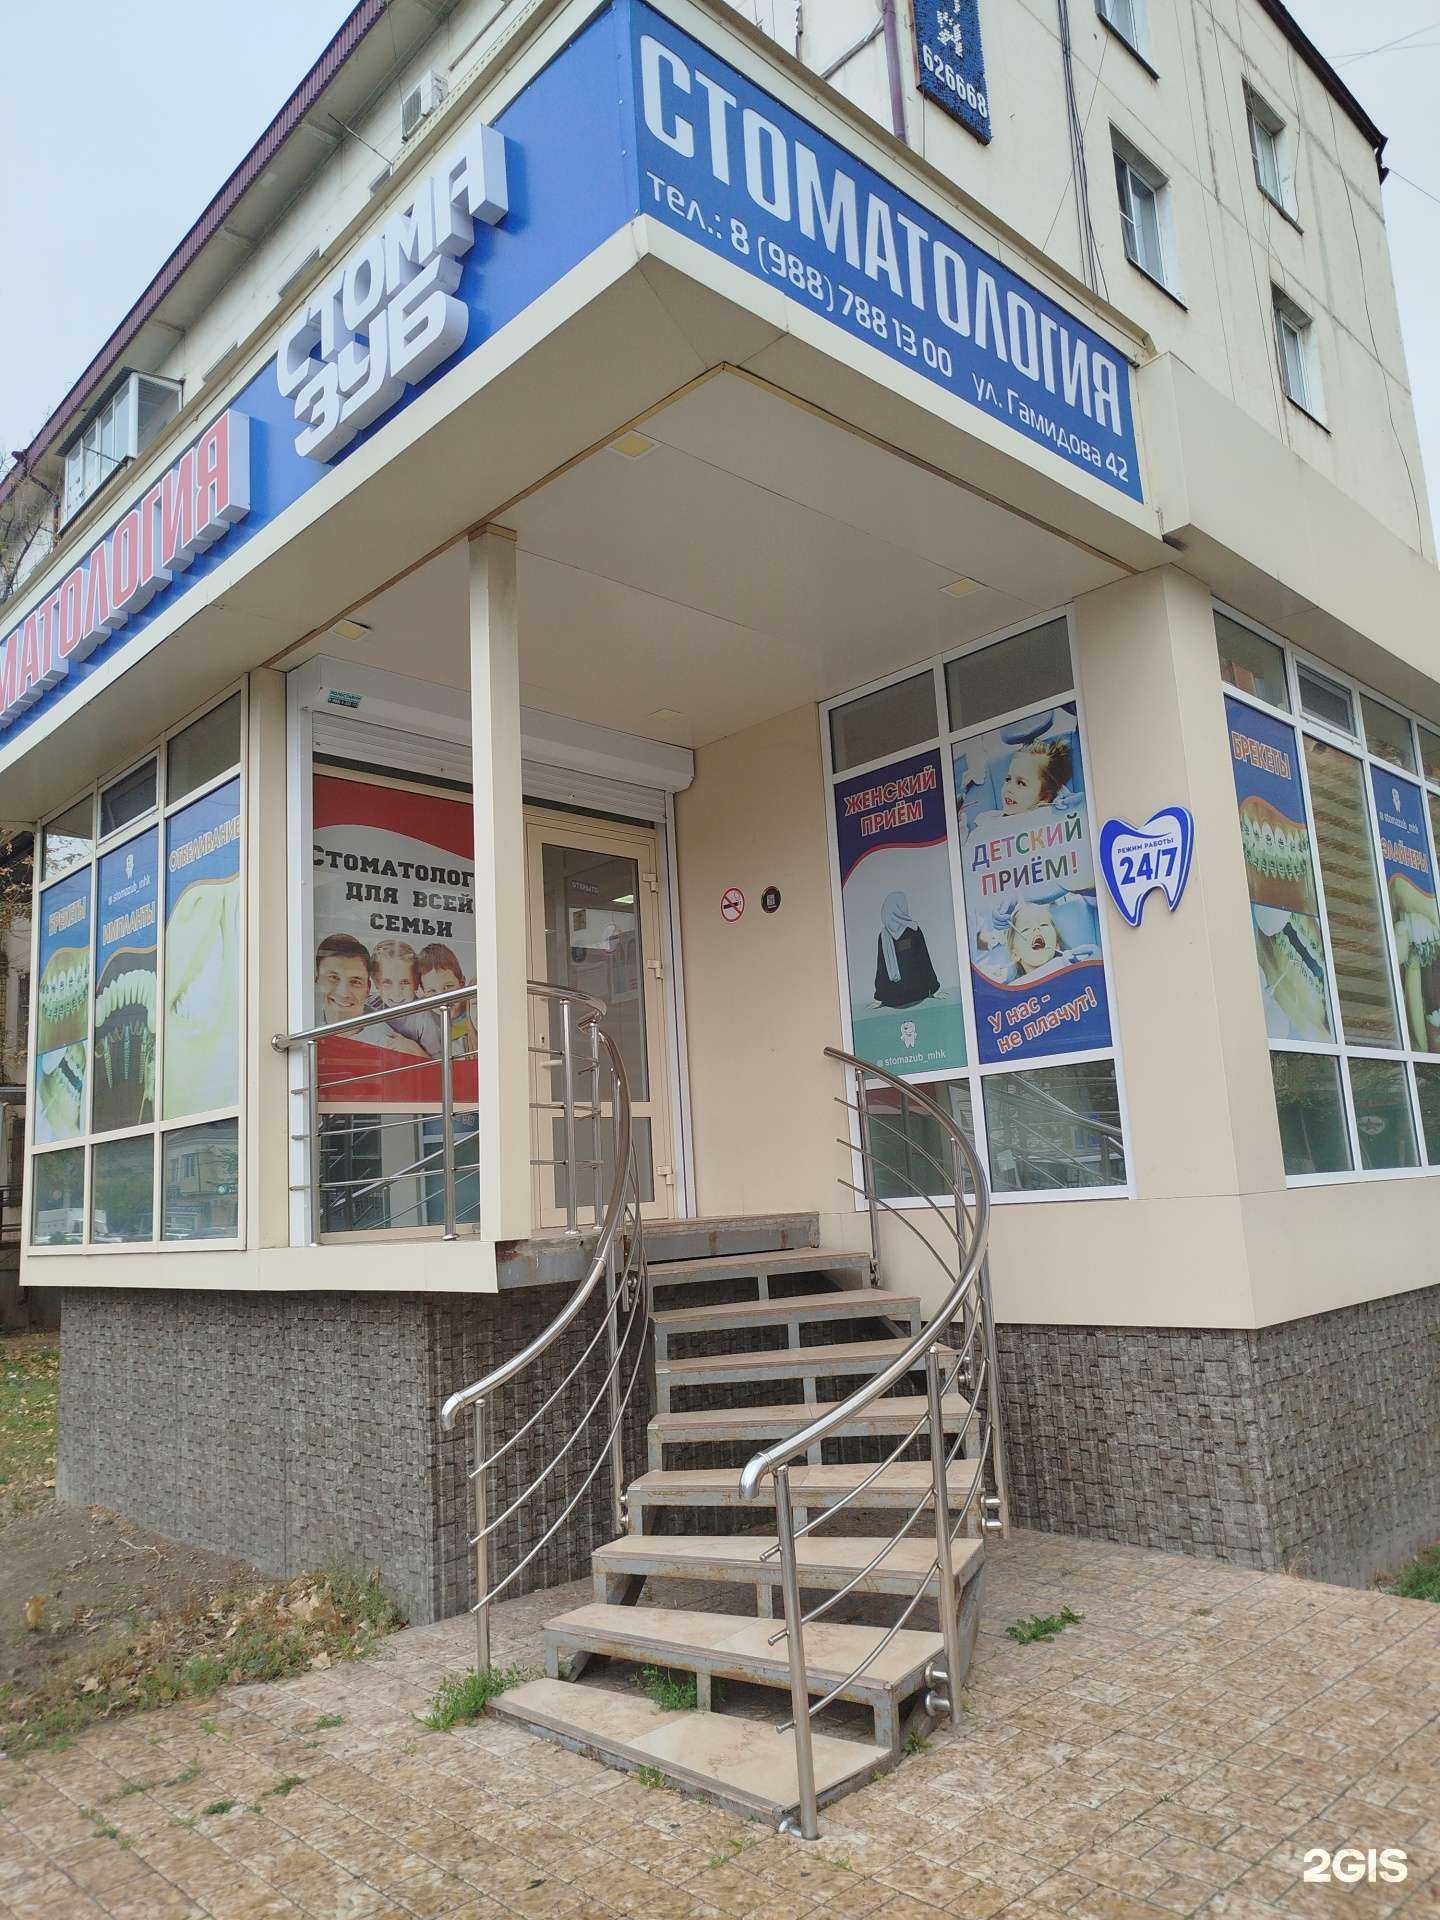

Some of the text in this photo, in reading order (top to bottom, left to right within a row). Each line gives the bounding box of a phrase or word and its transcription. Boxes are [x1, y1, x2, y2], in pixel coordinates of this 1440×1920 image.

[922, 44, 988, 118] 626668
[277, 122, 508, 398] СТОМА
[640, 34, 1123, 437] СТОМАТОЛОГИЯ
[647, 170, 952, 377] тел.: 8 (988) 788 13 00
[294, 254, 468, 457] ЗУБ
[971, 372, 1129, 482] ул. Гамидова 42
[1232, 730, 1291, 780] БРЕКЕТЫ
[844, 764, 937, 817] ЖЕНСКИЙ
[861, 799, 924, 837] ПРИЁМ
[971, 812, 1083, 872] ДЕТСКИЙ
[313, 844, 474, 888] СТОМАТОЛОГ
[1116, 837, 1174, 854] РЕЖИМ РАБОТЫ
[1119, 846, 1178, 886] 24/7
[346, 881, 474, 914] ДЛЯ ВСЕЙ
[981, 851, 1079, 896] ПРИЁМ!
[370, 912, 453, 938] СЕМЬИ
[997, 986, 1098, 1053] не плачут!
[1006, 997, 1040, 1026] нас
